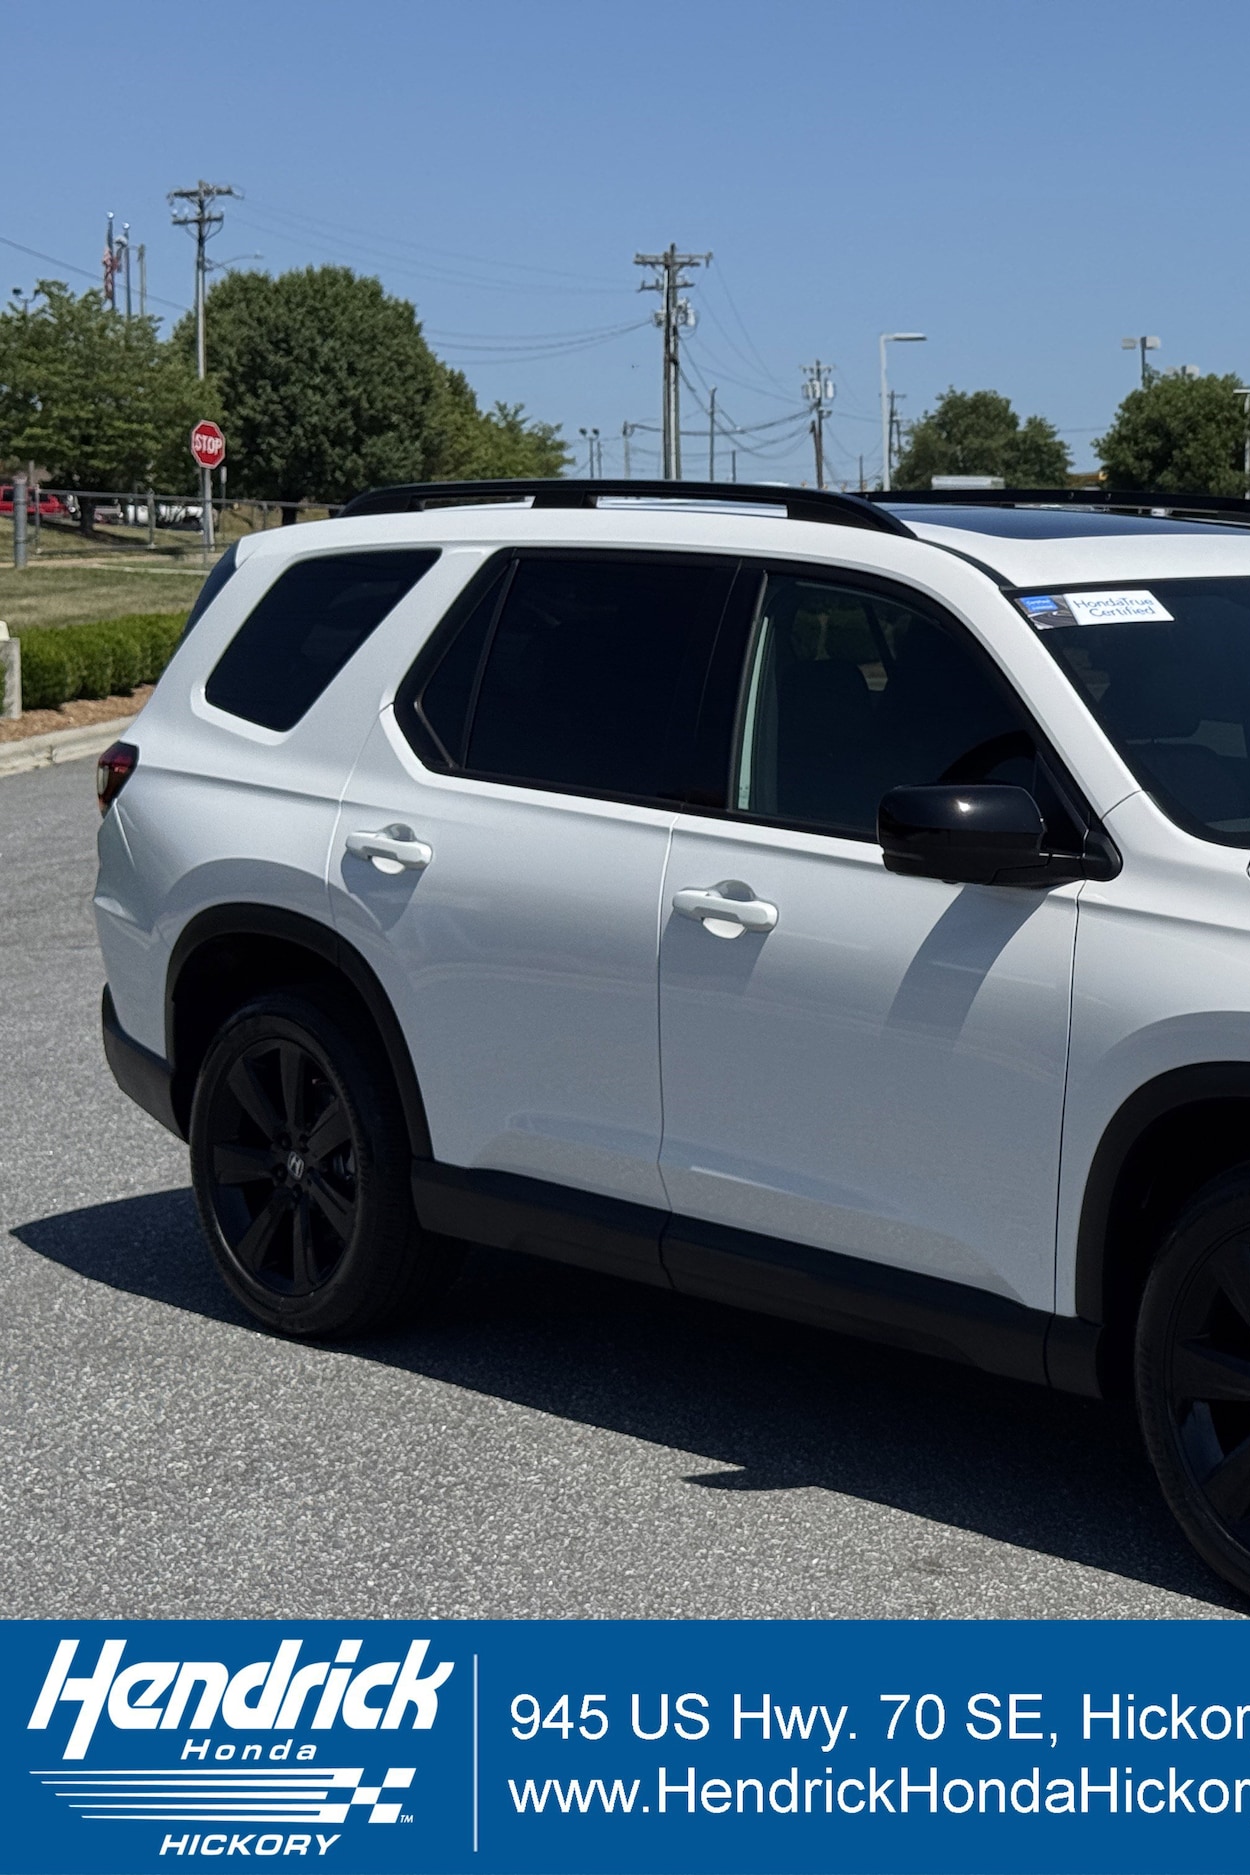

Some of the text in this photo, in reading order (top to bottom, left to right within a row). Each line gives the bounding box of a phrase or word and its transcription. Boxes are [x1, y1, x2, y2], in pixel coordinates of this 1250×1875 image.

[194, 433, 223, 455] STOP
[1073, 597, 1154, 609] HondaTrue
[1089, 606, 1155, 618] Certified
